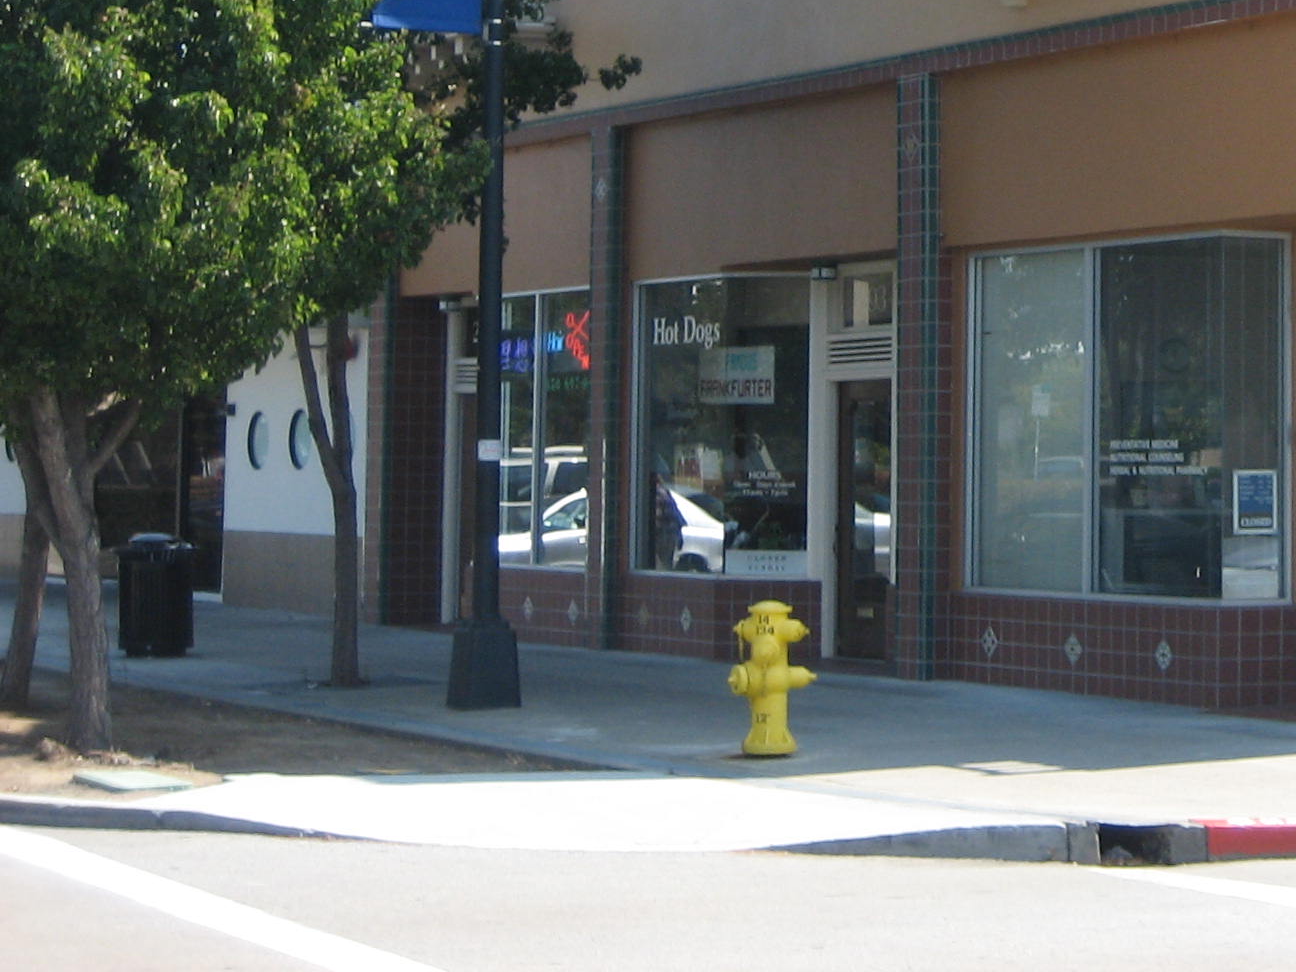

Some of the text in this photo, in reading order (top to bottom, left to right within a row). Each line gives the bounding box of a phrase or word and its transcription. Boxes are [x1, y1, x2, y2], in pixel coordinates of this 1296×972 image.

[653, 315, 720, 350] Hot Dogs
[700, 378, 773, 398] FRANKFURTER
